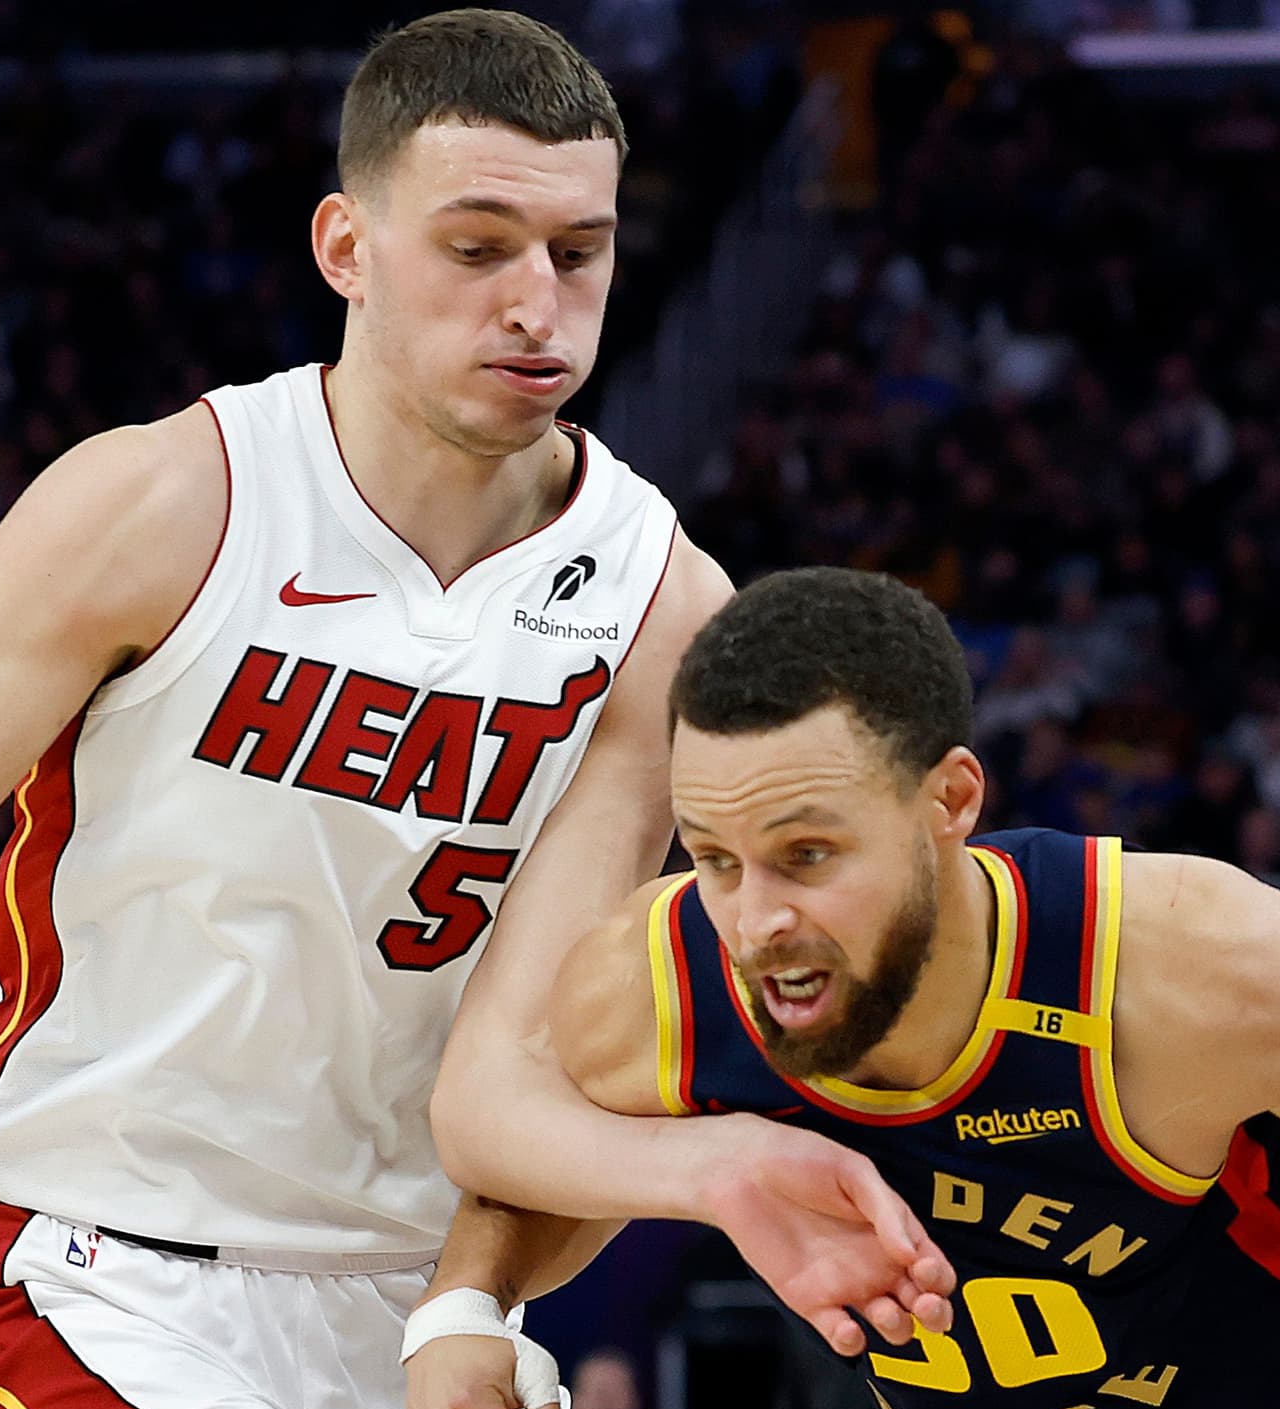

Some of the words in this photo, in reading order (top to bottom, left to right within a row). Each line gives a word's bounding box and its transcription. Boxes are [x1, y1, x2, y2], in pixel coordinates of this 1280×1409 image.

[513, 608, 619, 642] Robinhood
[192, 645, 611, 826] HEAT
[376, 841, 520, 973] 5
[1033, 1009, 1064, 1035] 16
[955, 1106, 1081, 1145] Rakuten
[932, 1171, 1148, 1277] DEN
